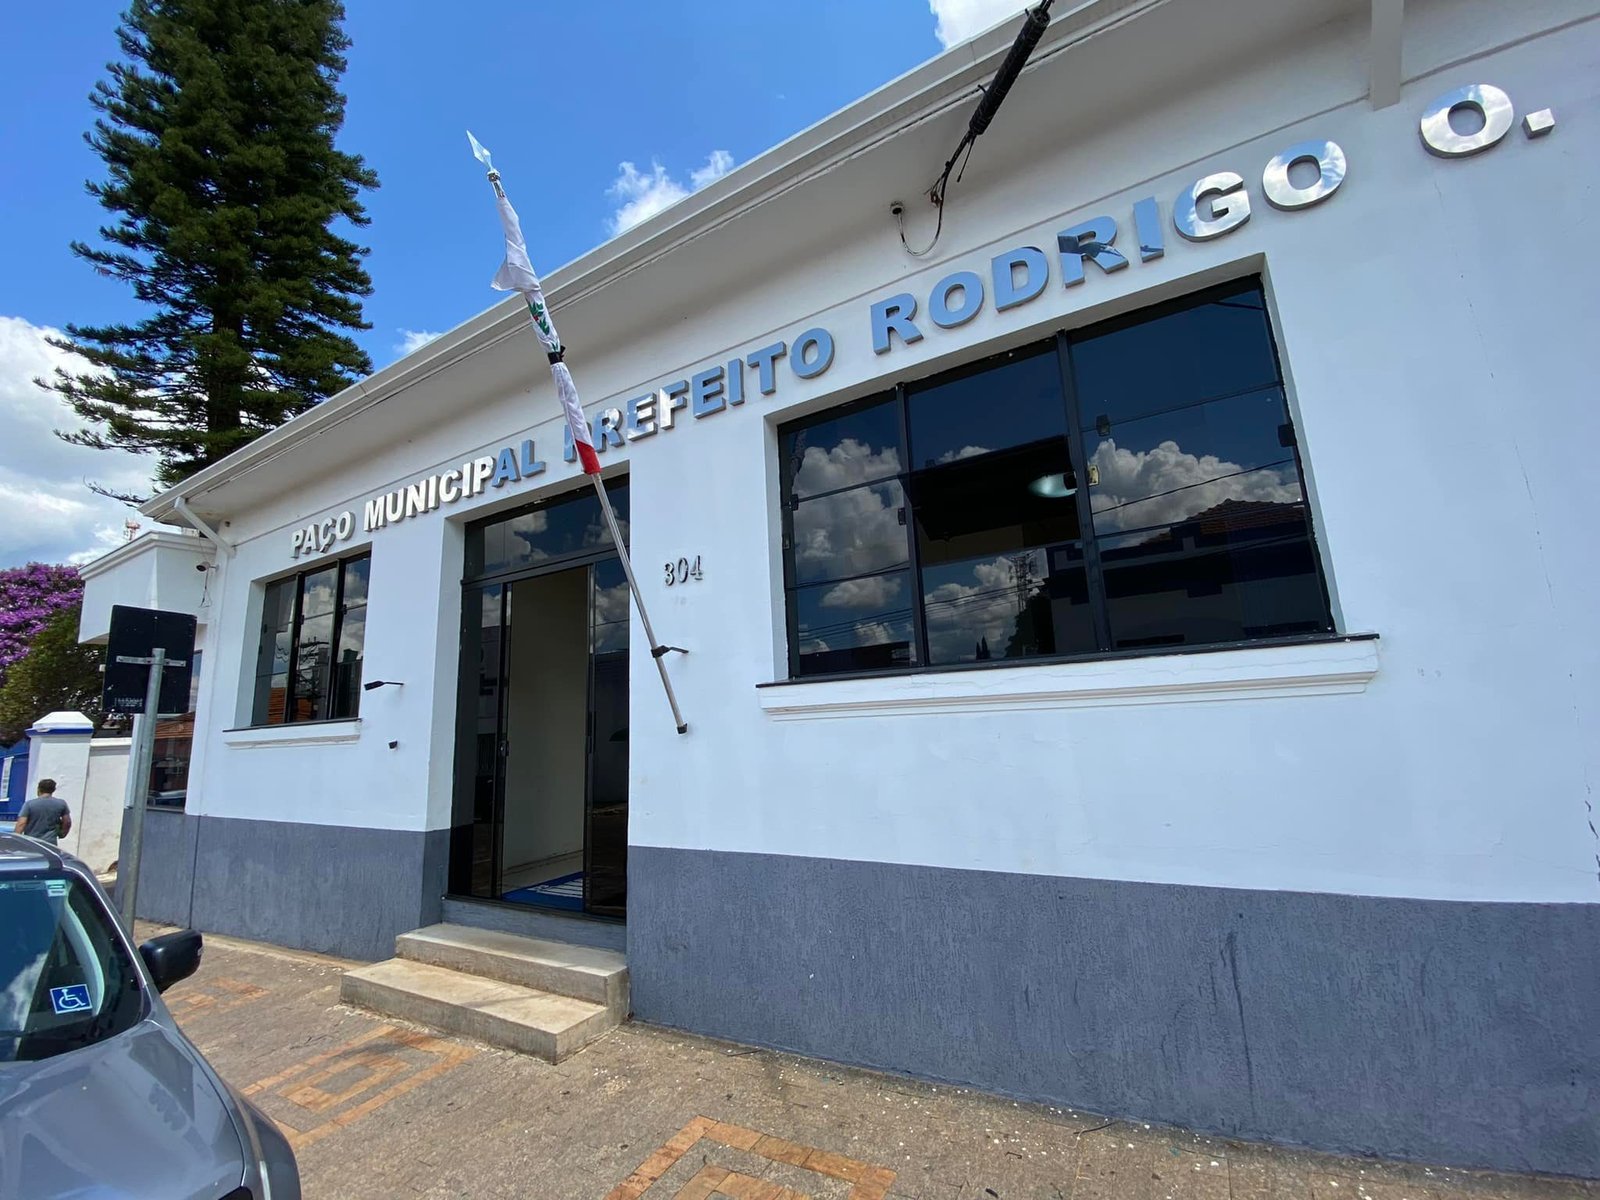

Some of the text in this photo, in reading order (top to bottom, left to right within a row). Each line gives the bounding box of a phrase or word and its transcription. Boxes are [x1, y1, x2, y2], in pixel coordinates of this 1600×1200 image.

[290, 511, 356, 559] PAÇO
[364, 439, 546, 532] MUNICIPAL
[870, 139, 1347, 354] RODRIGO
[1419, 84, 1555, 159] O.
[665, 555, 703, 586] 304
